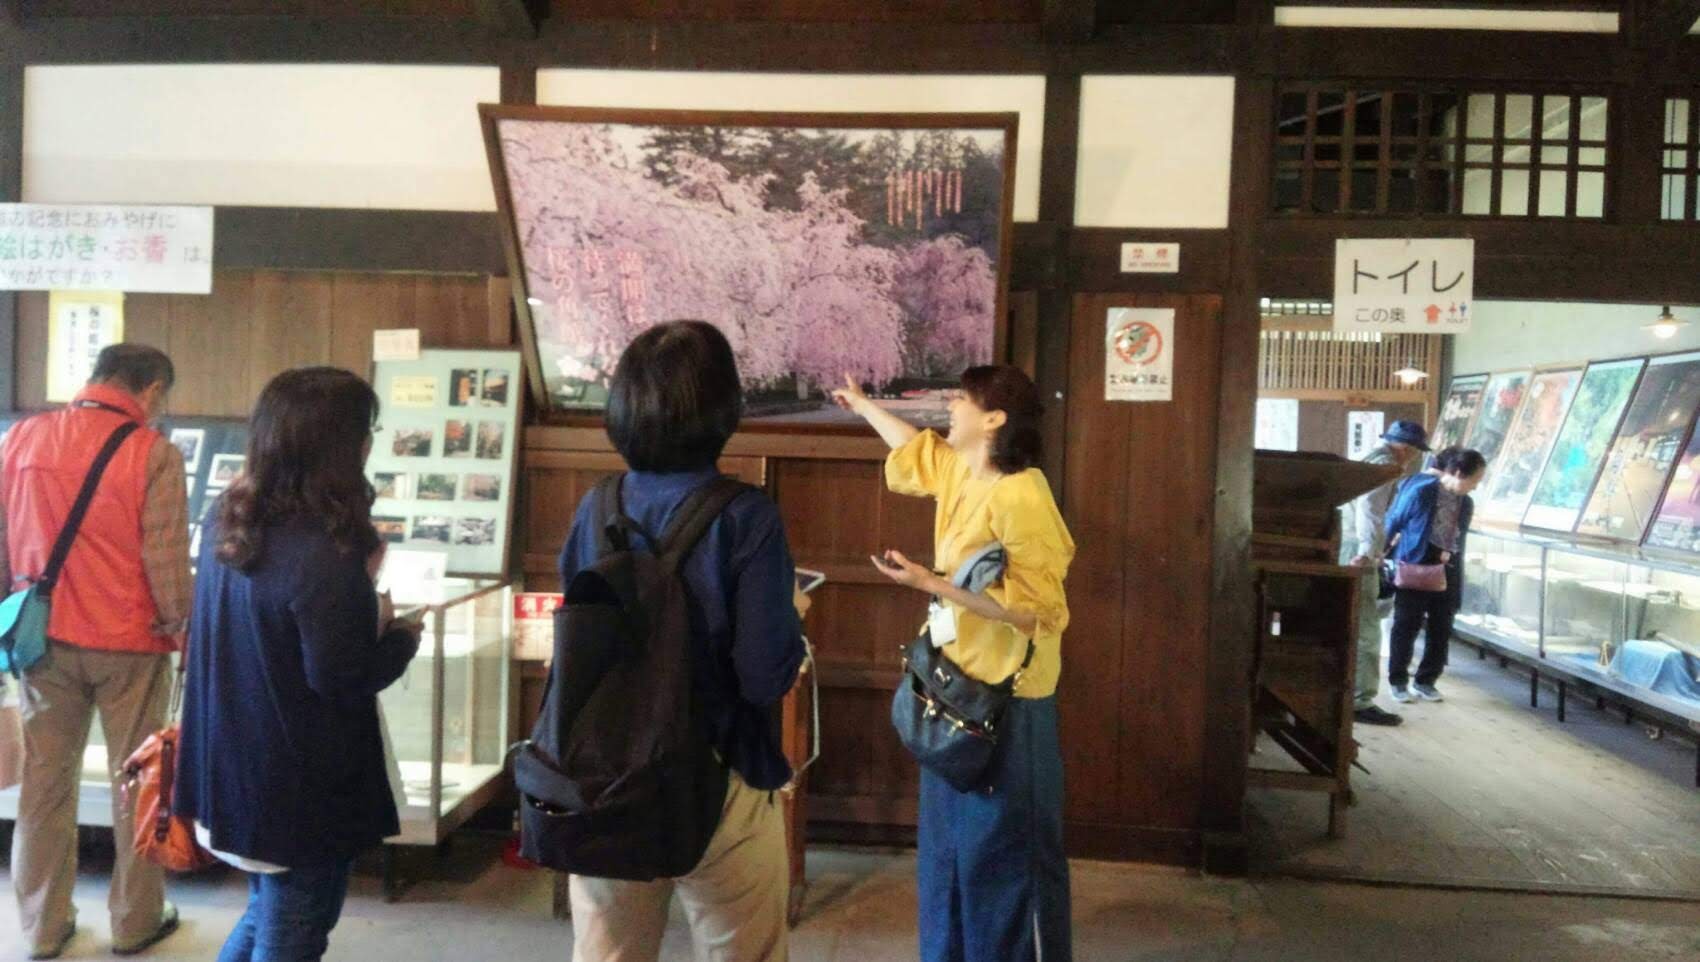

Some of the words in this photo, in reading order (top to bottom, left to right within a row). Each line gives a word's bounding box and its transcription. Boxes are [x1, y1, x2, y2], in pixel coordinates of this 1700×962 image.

[1352, 258, 1465, 295] トイレ
[1354, 306, 1407, 324] この奥
